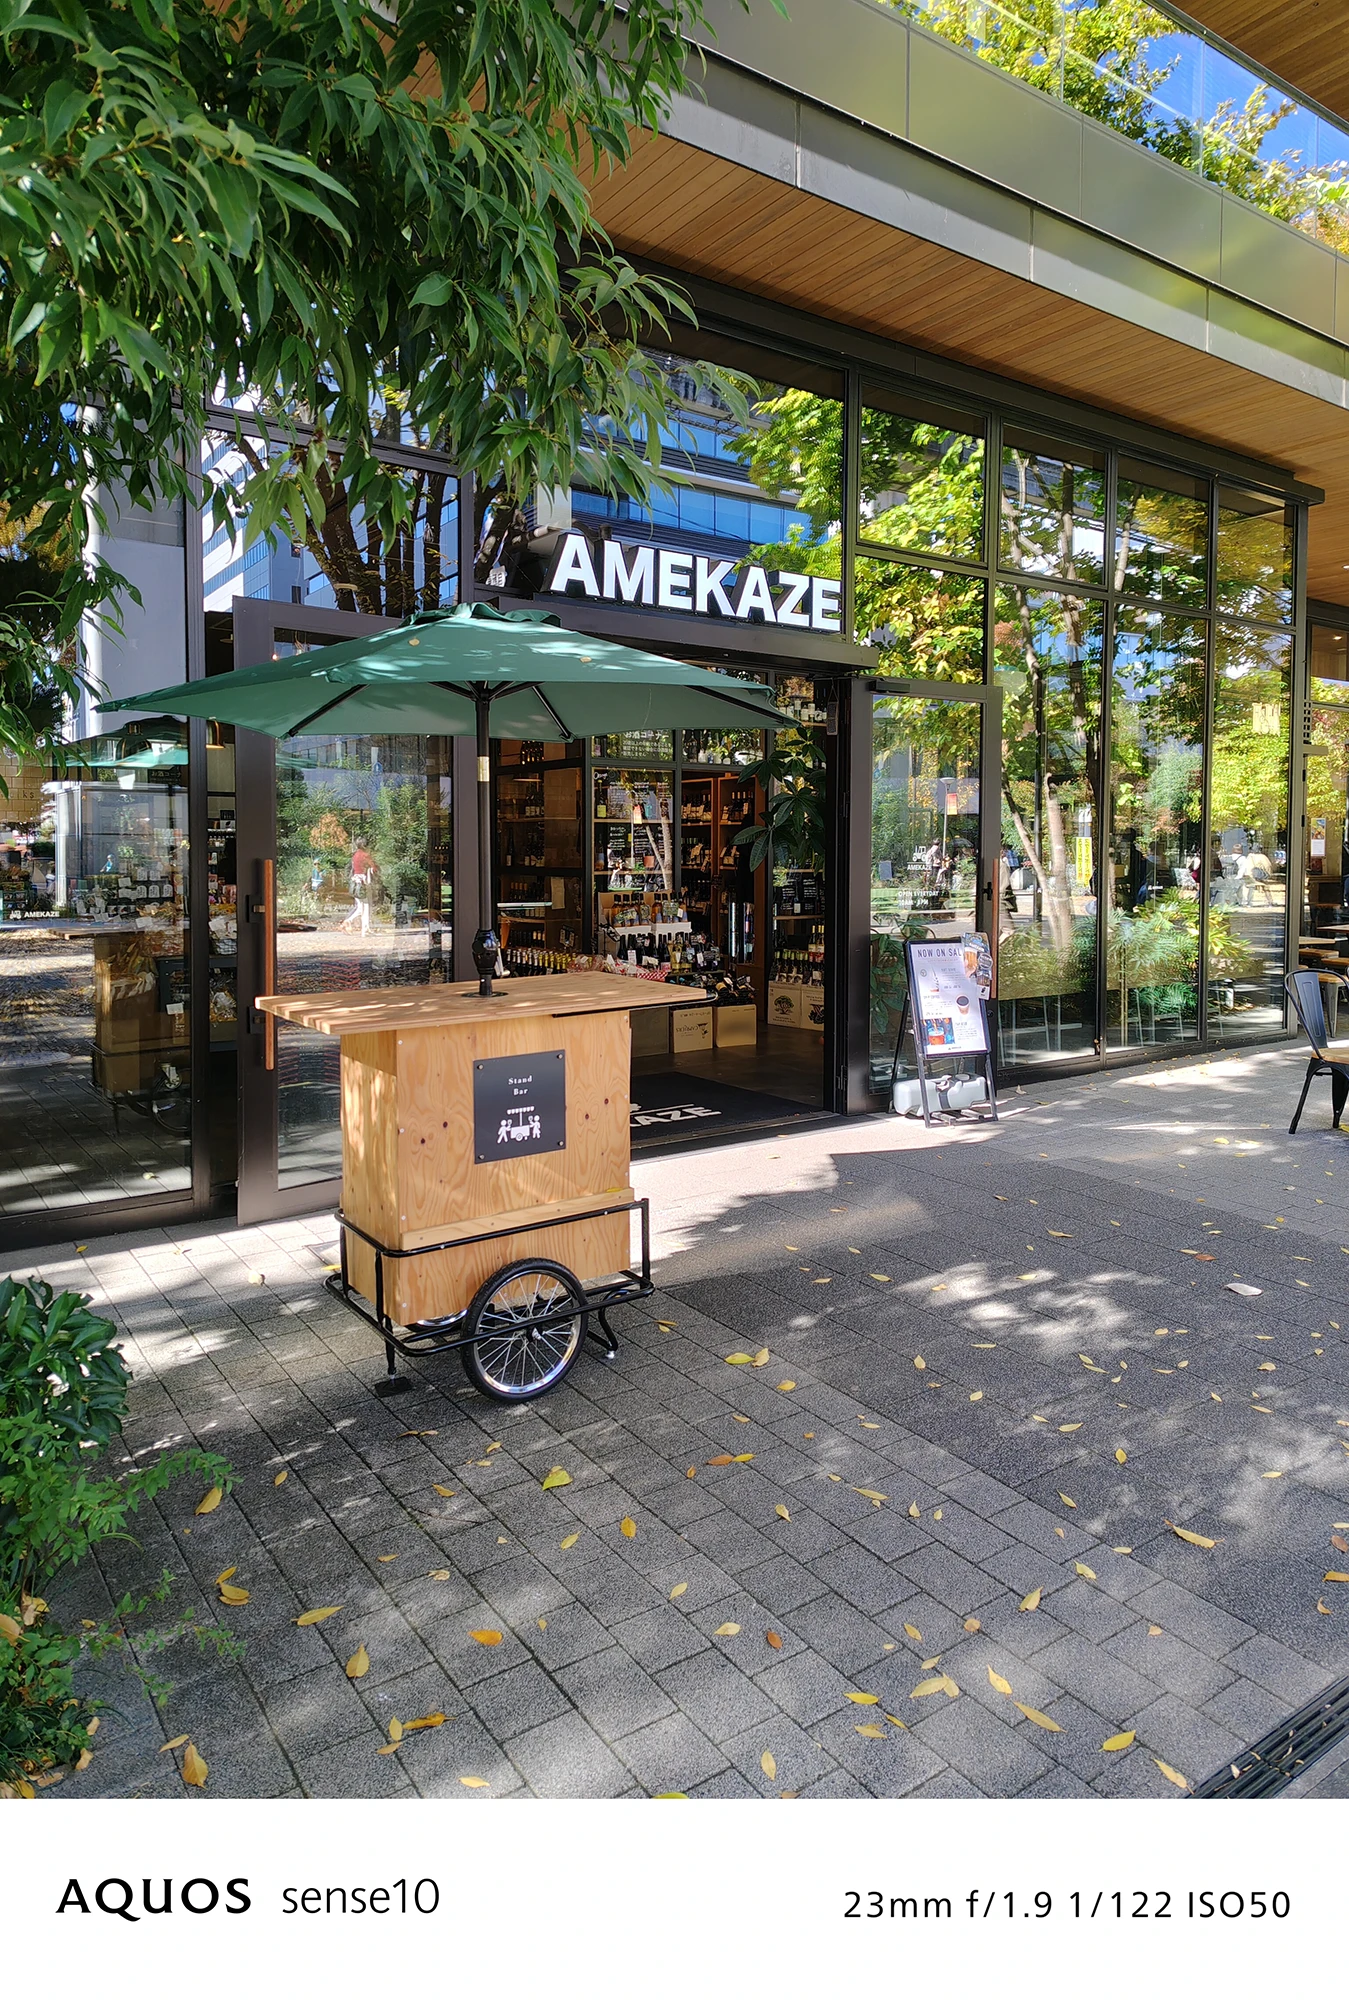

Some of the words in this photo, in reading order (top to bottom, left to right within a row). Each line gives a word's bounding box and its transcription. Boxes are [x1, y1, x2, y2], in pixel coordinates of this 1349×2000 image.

[550, 533, 842, 632] AMEKAZE
[24, 910, 60, 918] AMEKAZE
[917, 949, 933, 958] NOW
[936, 948, 946, 957] ON
[948, 948, 962, 957] SAL
[508, 1075, 533, 1085] Stand
[513, 1088, 528, 1096] Bar
